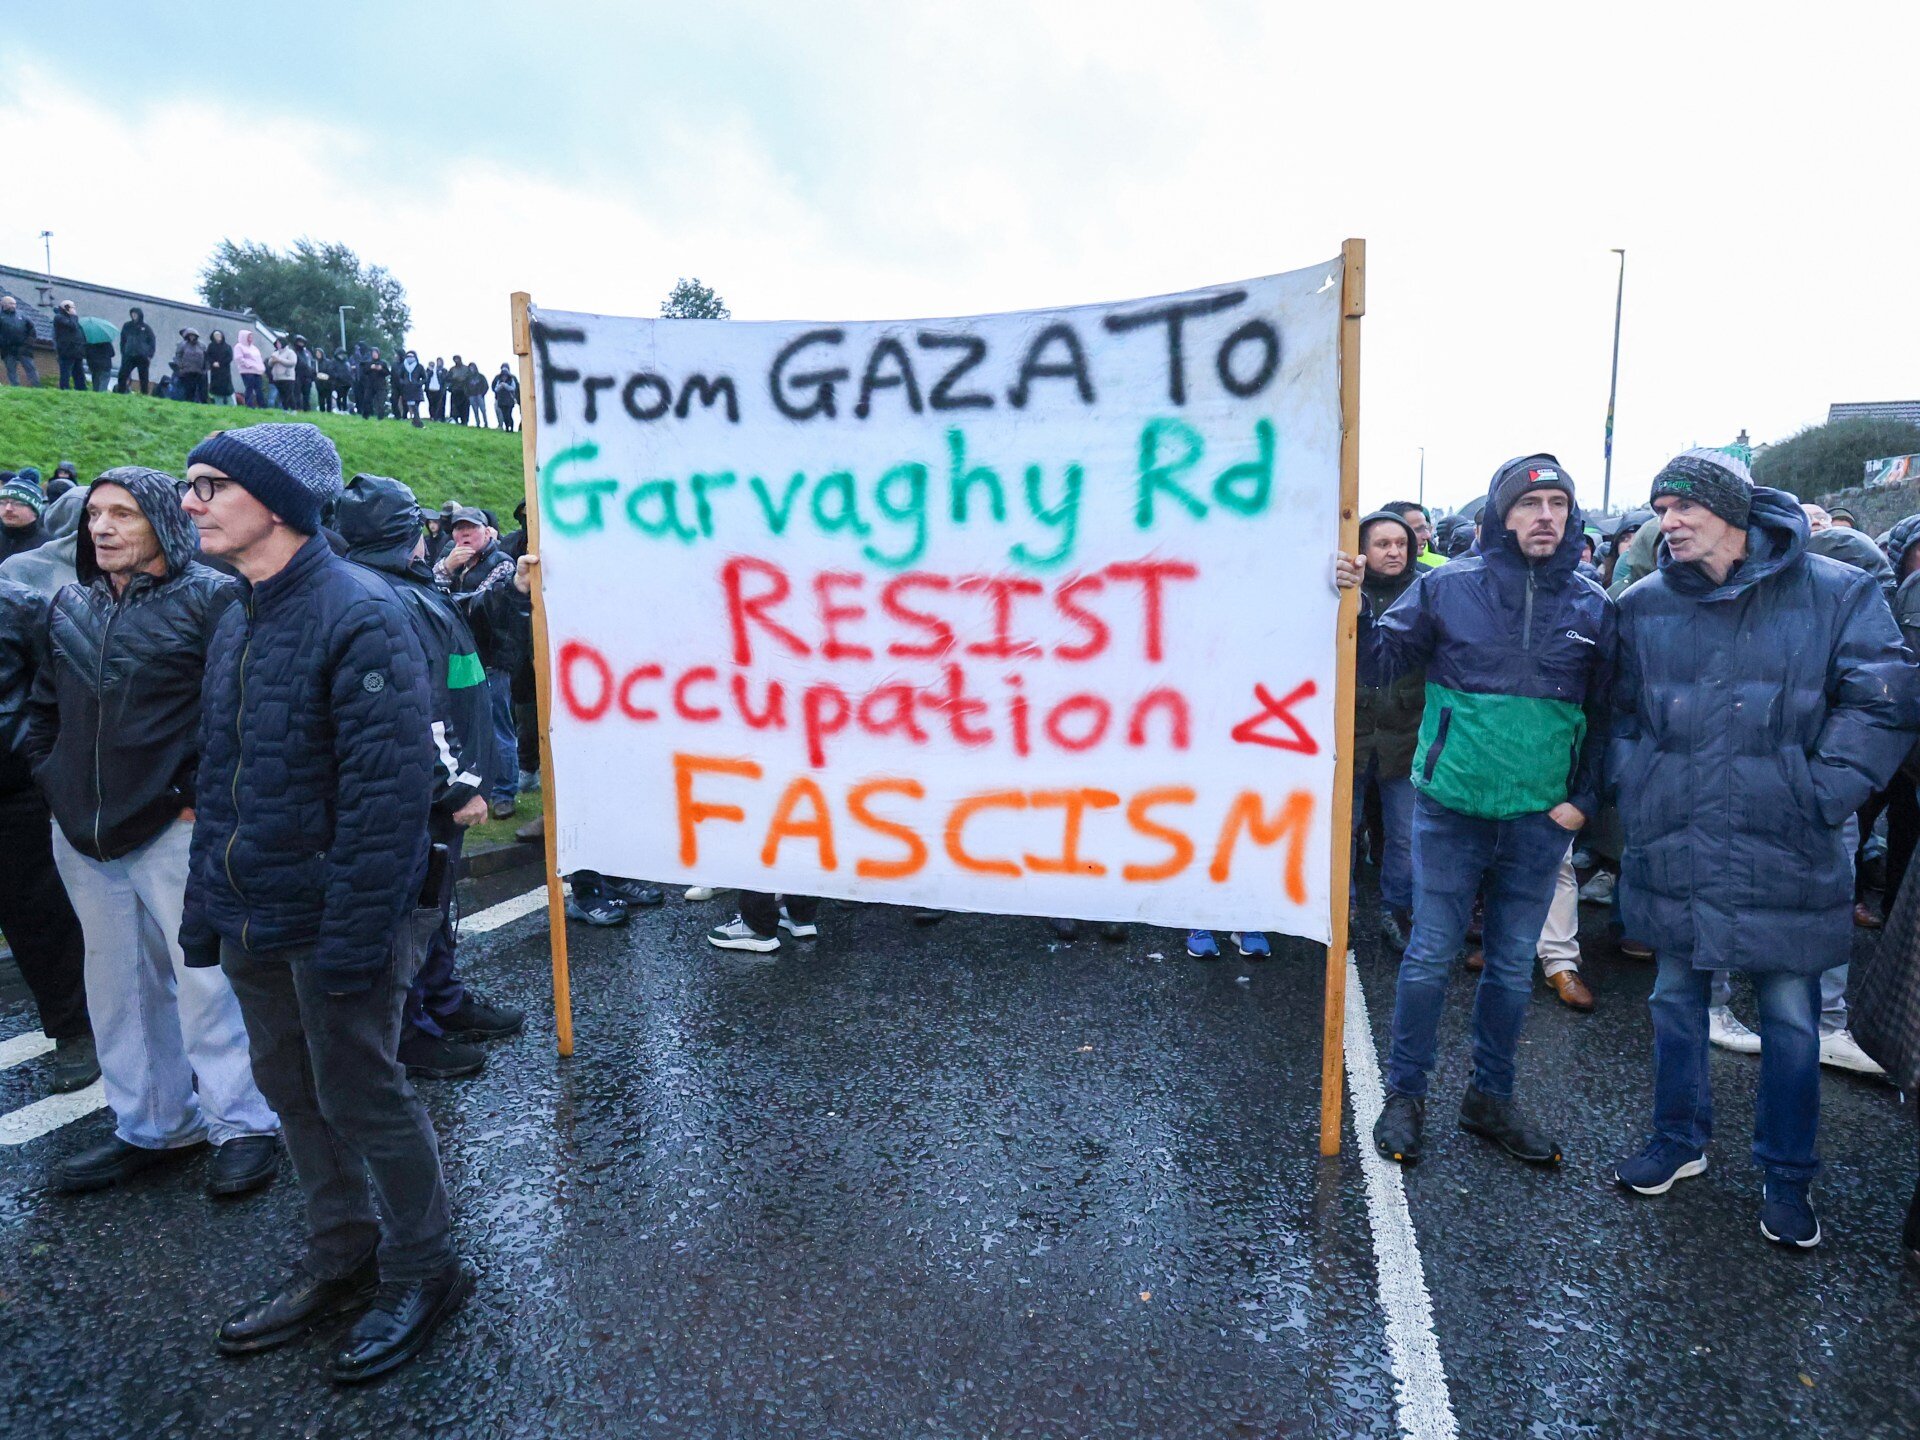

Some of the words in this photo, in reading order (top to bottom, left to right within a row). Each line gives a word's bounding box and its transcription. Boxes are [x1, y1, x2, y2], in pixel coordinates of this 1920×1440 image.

[769, 325, 1094, 420] GAZA
[542, 426, 1085, 570] Garvaghy
[1134, 415, 1278, 530] Rd
[720, 556, 1199, 666] RESIST
[558, 639, 1190, 768] Occupation
[673, 752, 1315, 904] FASCISM
